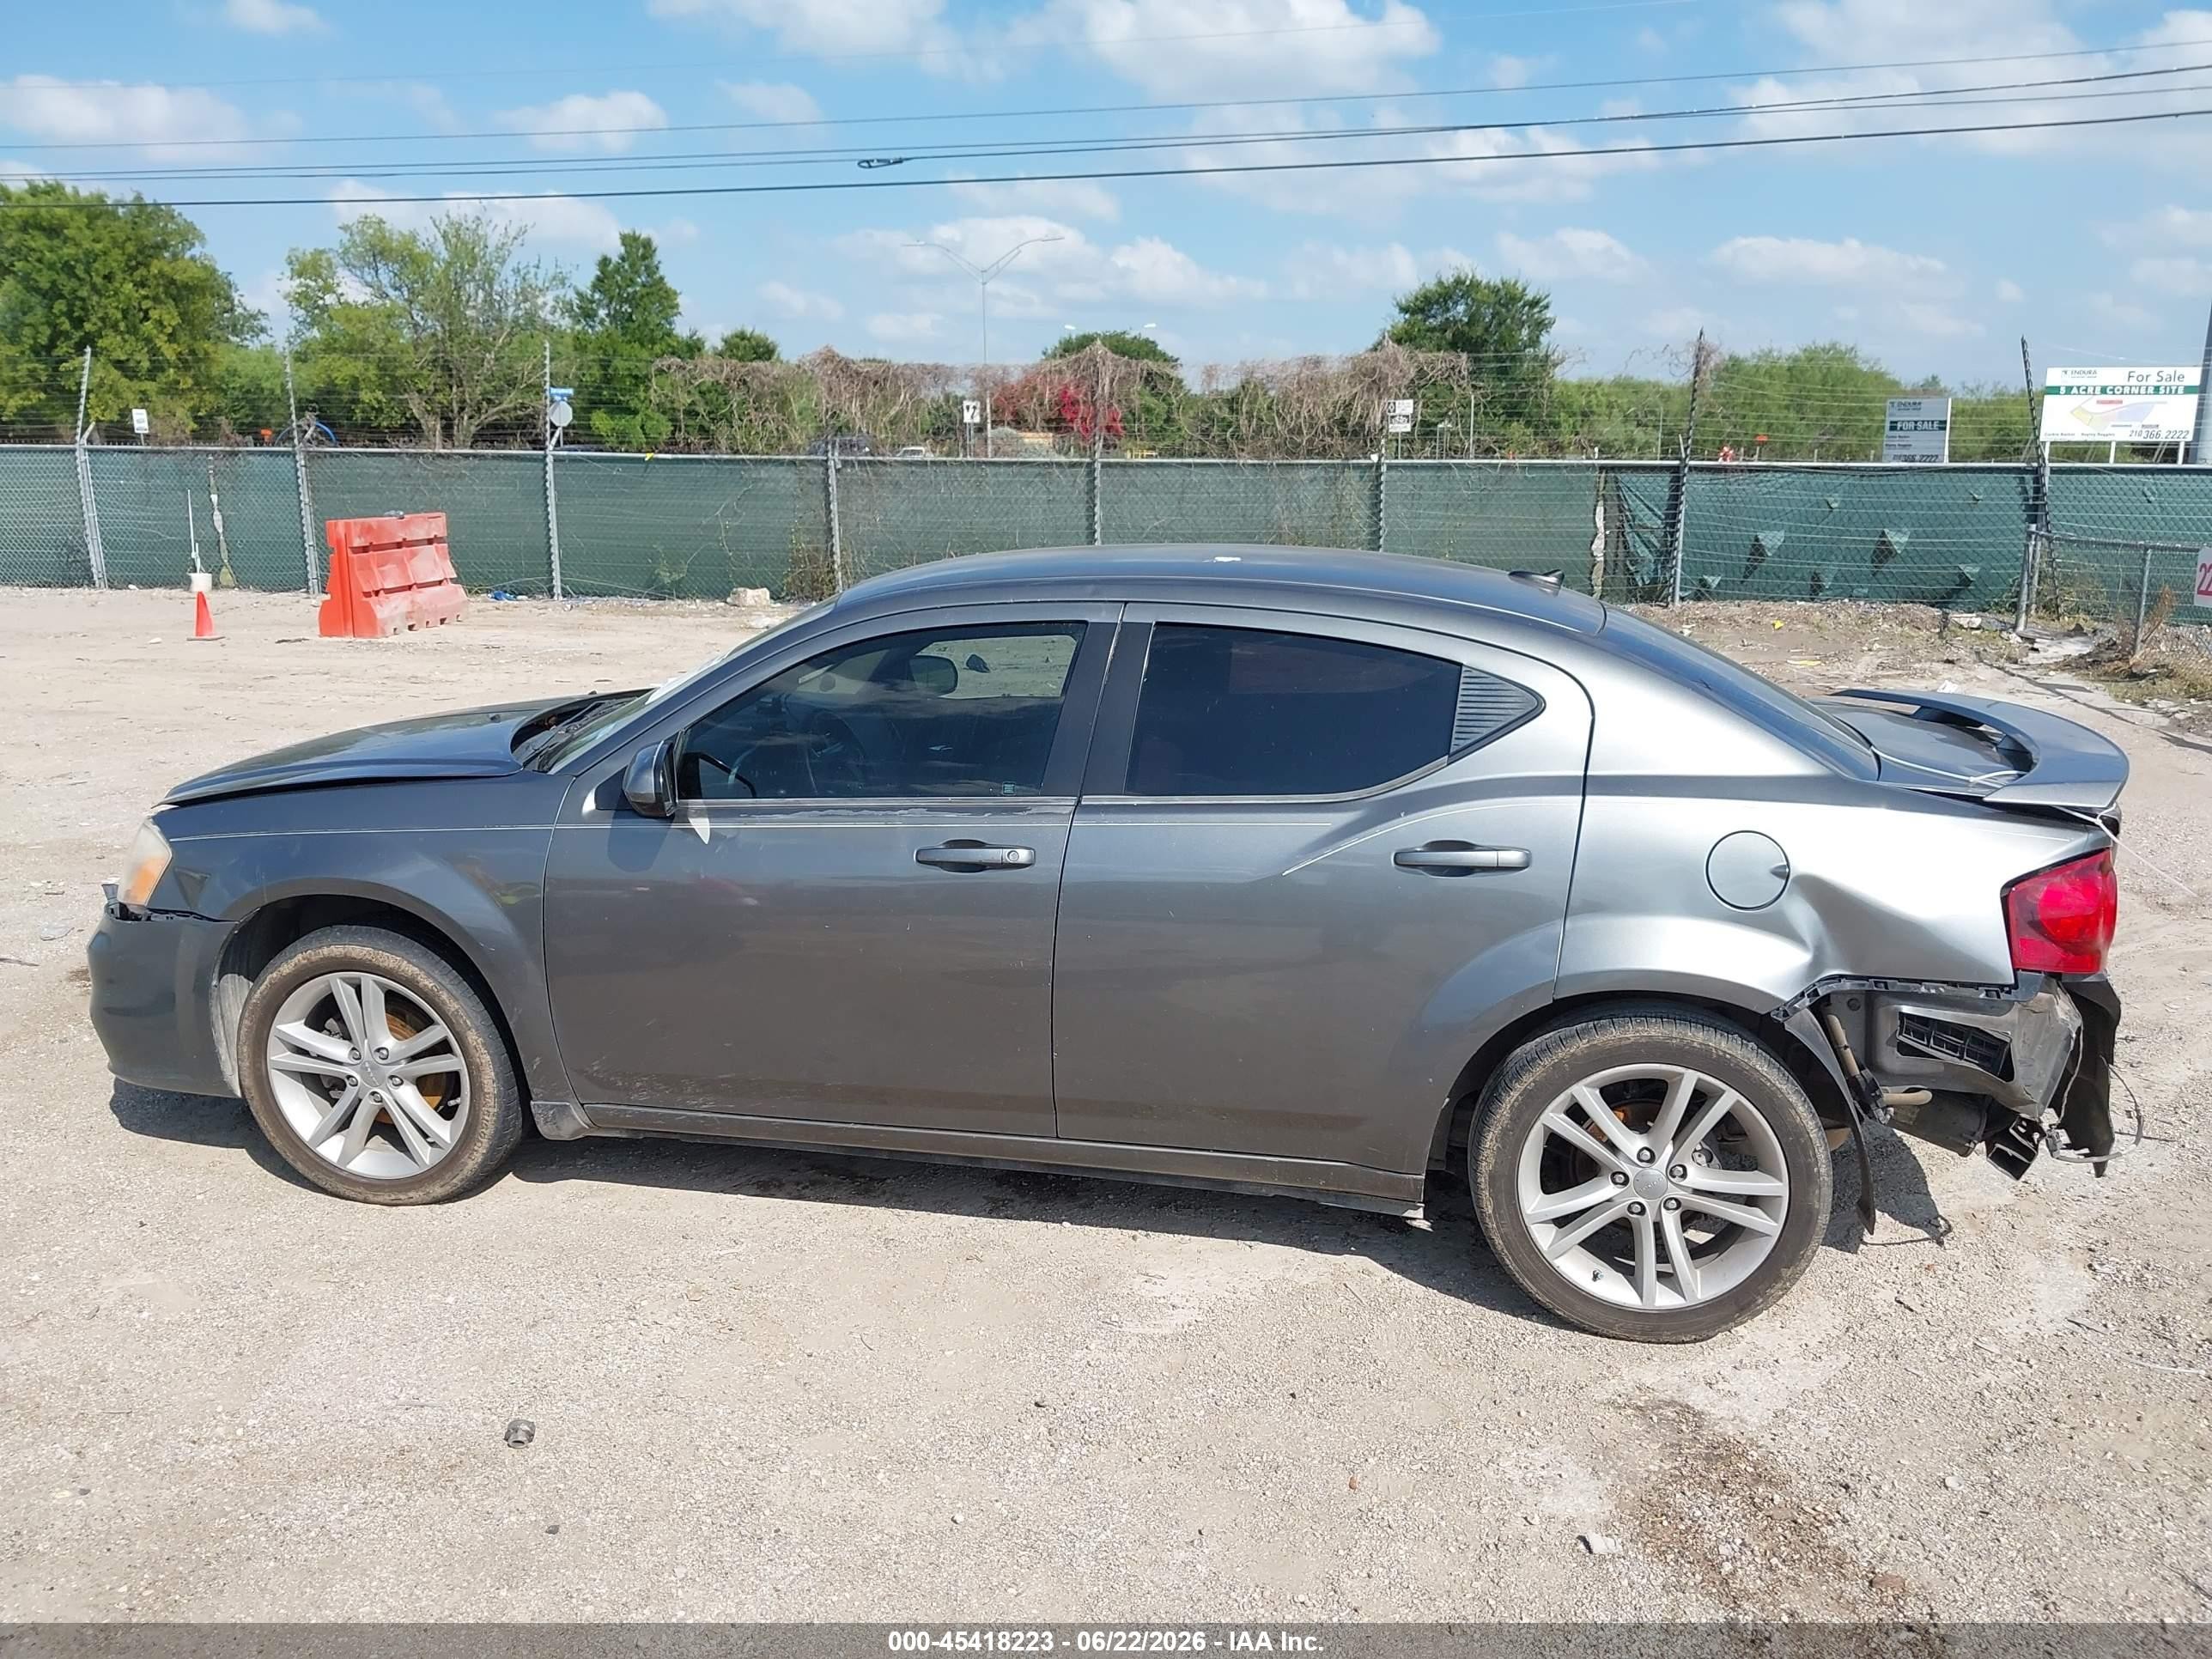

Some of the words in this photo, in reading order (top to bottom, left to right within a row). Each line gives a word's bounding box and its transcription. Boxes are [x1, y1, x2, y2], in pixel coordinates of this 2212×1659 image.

[2127, 370, 2151, 383] For
[2156, 370, 2185, 383] Sale
[2059, 386, 2066, 395] 5
[2070, 386, 2102, 395] ACRE
[2106, 386, 2155, 394] CORNER
[2158, 386, 2185, 394] SITE
[1897, 421, 1915, 430] FOR
[1916, 421, 1940, 430] SALE
[2143, 430, 2191, 440] 366.2222
